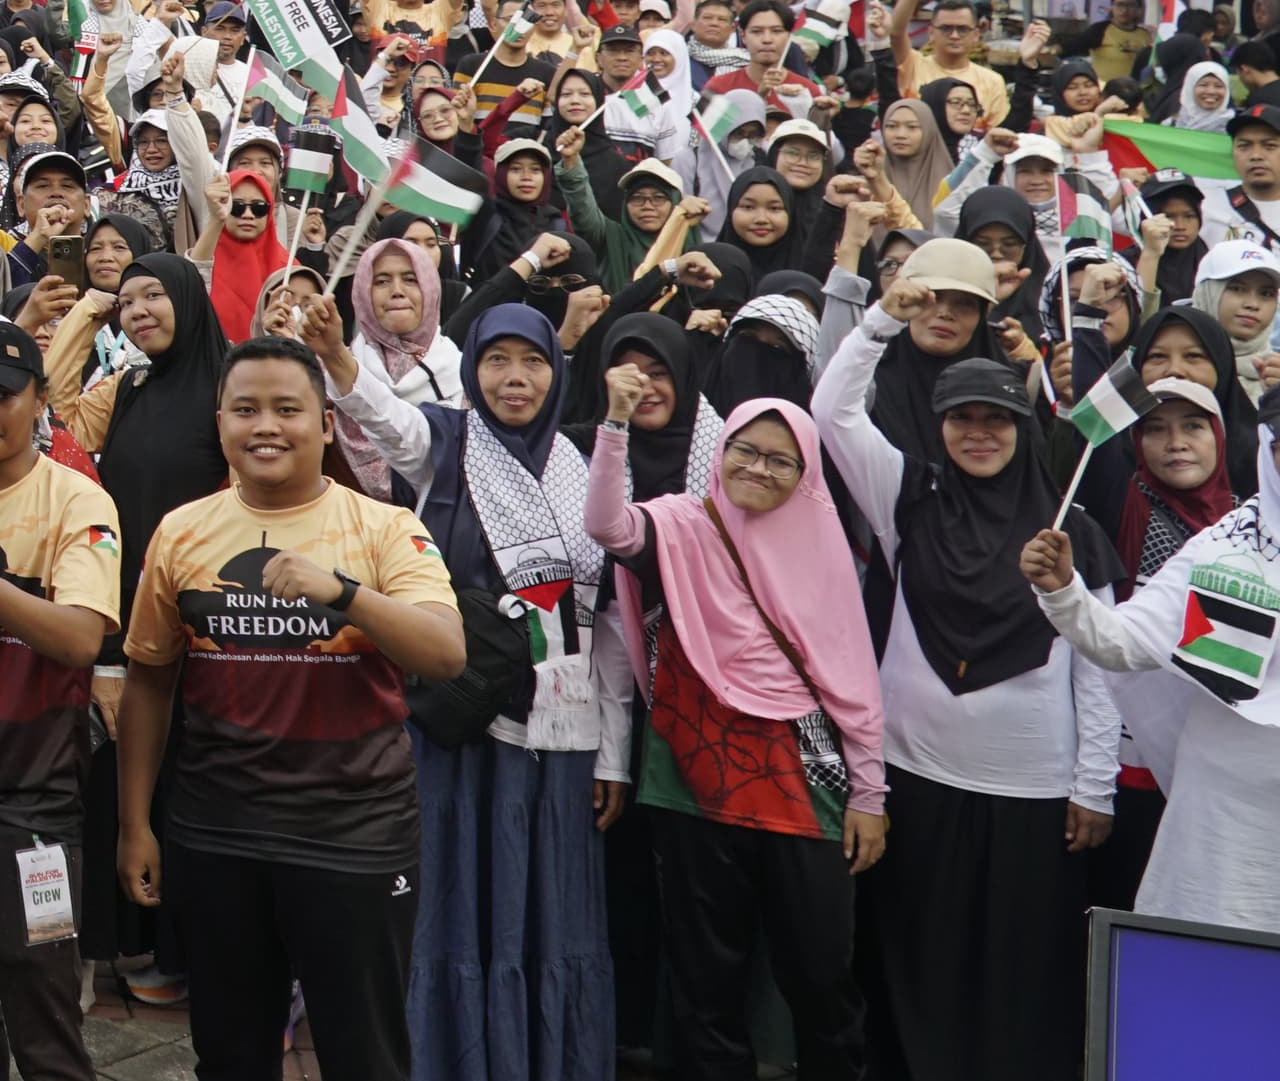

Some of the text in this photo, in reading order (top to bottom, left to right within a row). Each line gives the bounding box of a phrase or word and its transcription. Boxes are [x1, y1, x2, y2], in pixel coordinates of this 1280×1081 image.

[284, 1, 311, 33] FREE
[226, 593, 266, 608] RUN
[206, 615, 331, 637] FREEDOM
[253, 653, 284, 663] Adalah
[285, 654, 302, 663] Hak
[303, 654, 333, 664] Segala
[32, 887, 61, 906] Crew
